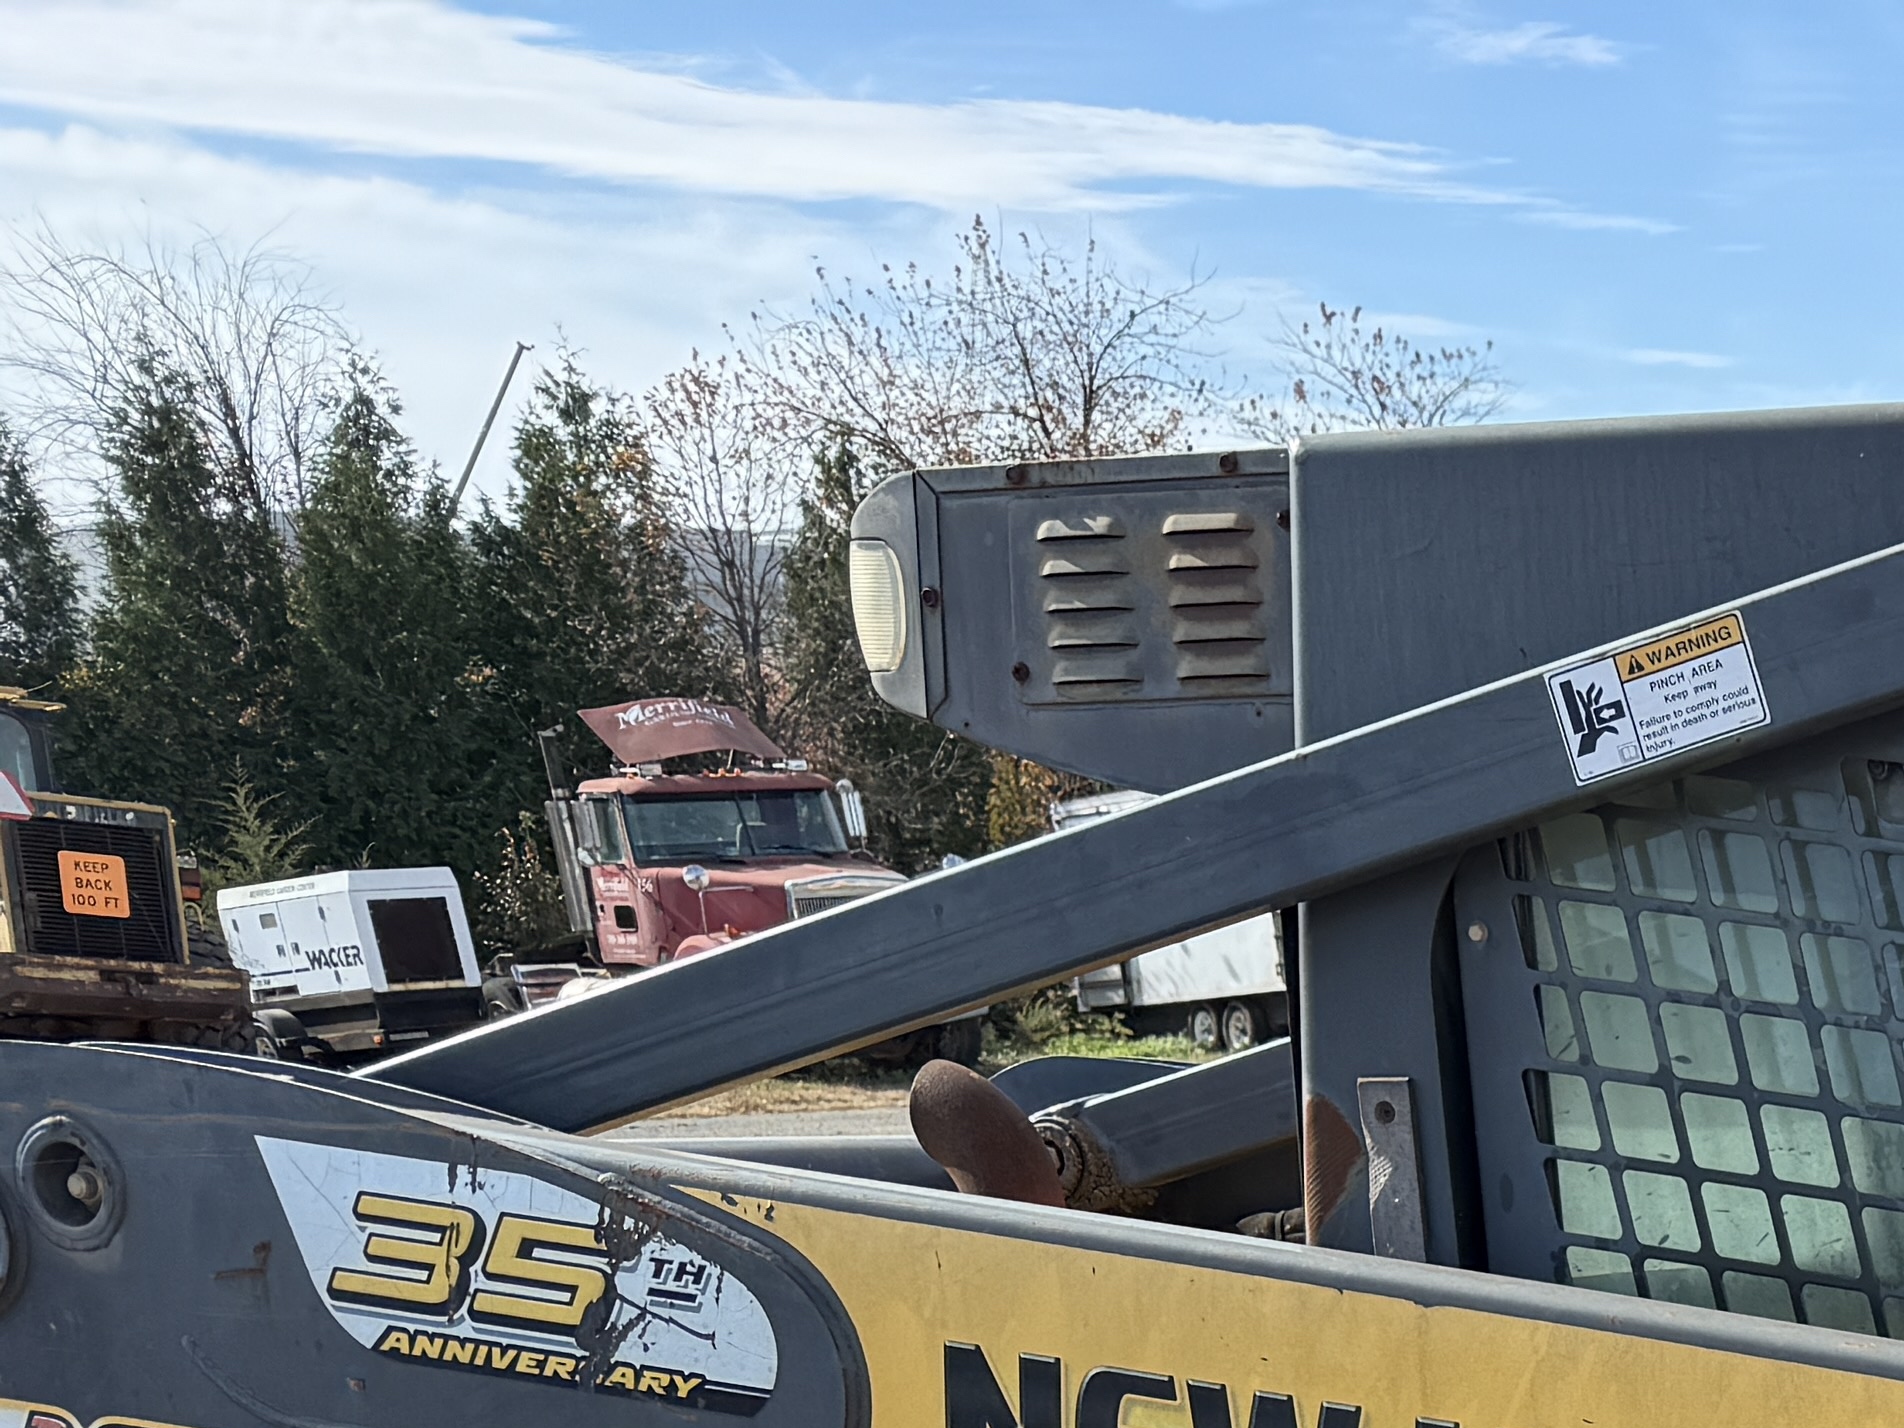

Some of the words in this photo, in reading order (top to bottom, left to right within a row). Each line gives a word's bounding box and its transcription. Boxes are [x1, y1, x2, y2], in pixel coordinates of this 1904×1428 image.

[1645, 625, 1733, 666] WARNING
[1649, 672, 1685, 693] PINCH
[1691, 659, 1724, 679] AREA
[1638, 711, 1672, 731] Failure
[1673, 705, 1684, 718] to
[1685, 694, 1721, 715] comply
[1722, 685, 1750, 702] could
[1664, 687, 1689, 704] Keep
[614, 698, 737, 730] Merrifield
[1643, 724, 1670, 742] result
[1670, 723, 1680, 733] in
[1681, 713, 1708, 730] death
[1709, 709, 1720, 720] or
[1722, 697, 1757, 716] serious
[74, 860, 109, 874] KEEP
[72, 893, 97, 907] 100
[105, 897, 120, 908] FT
[75, 877, 112, 892] BACK
[304, 945, 364, 970] WACKER
[326, 1190, 612, 1336] 35
[648, 1256, 708, 1288] TH
